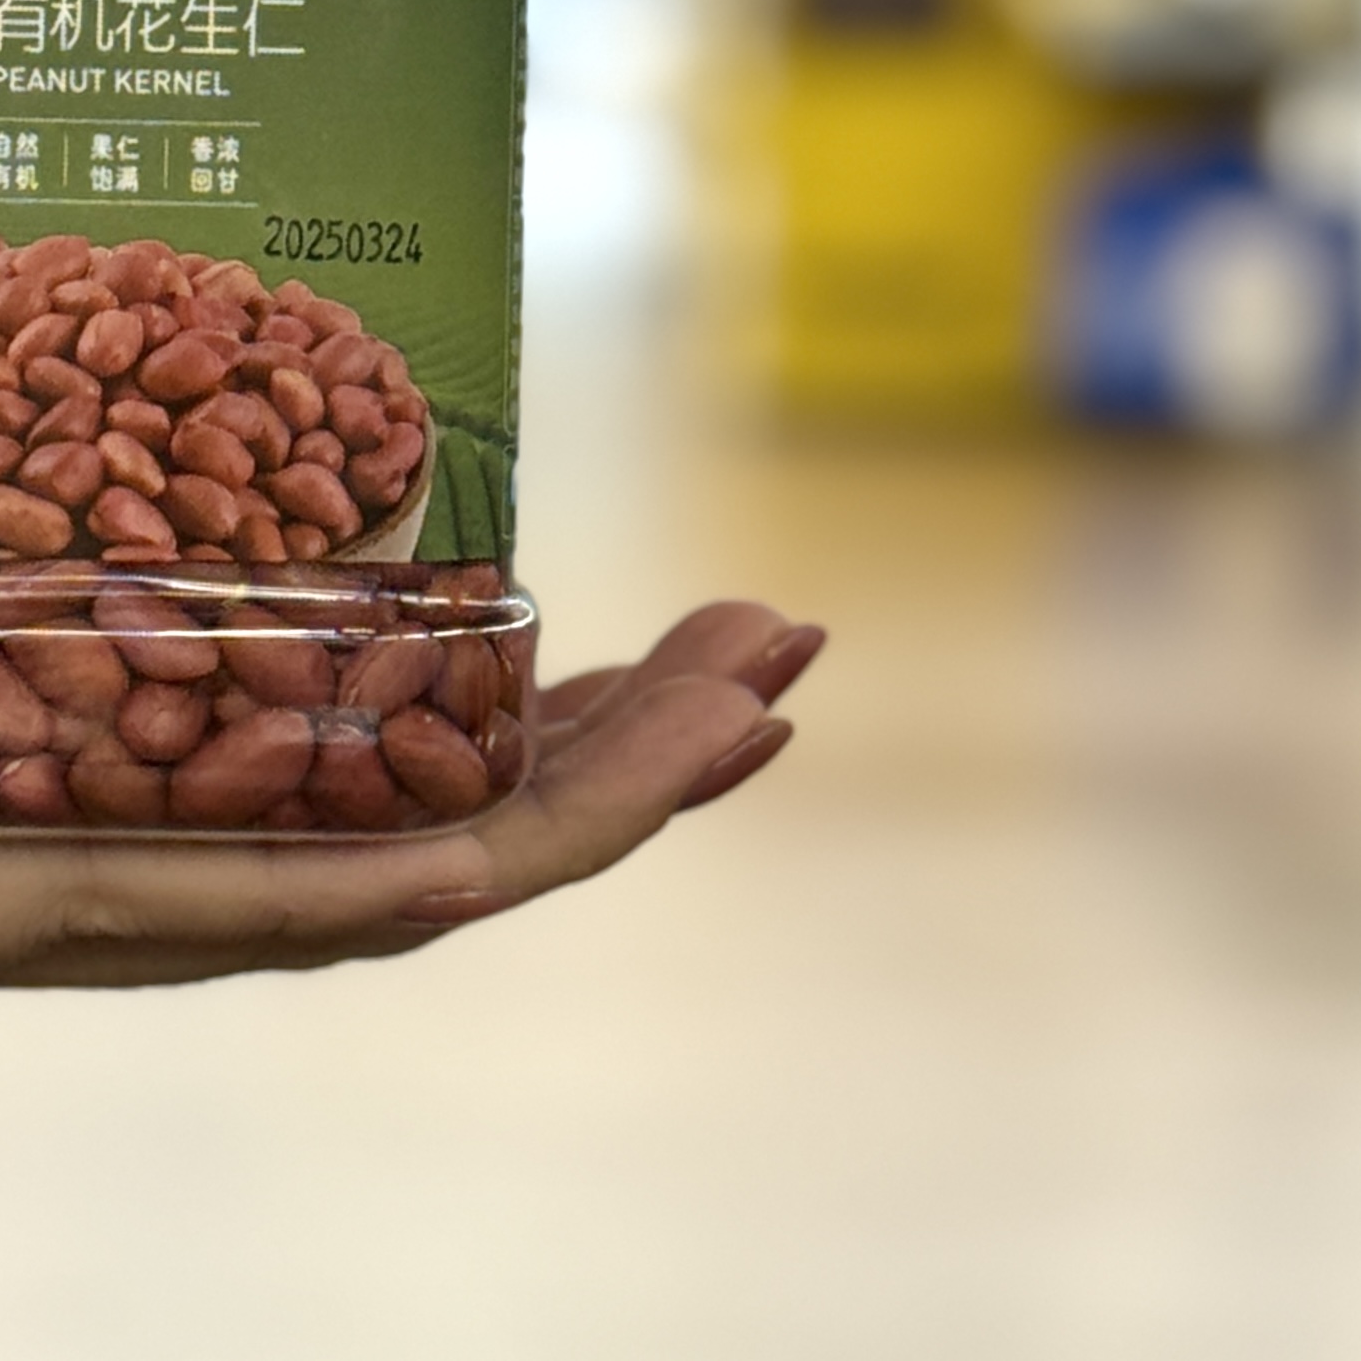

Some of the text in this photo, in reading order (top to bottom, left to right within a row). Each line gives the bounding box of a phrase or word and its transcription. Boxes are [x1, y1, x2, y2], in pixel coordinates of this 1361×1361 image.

[114, 69, 231, 97] KERNEL
[90, 133, 140, 161] 果仁
[190, 166, 239, 194] 回甘
[264, 215, 423, 264] 20250324
